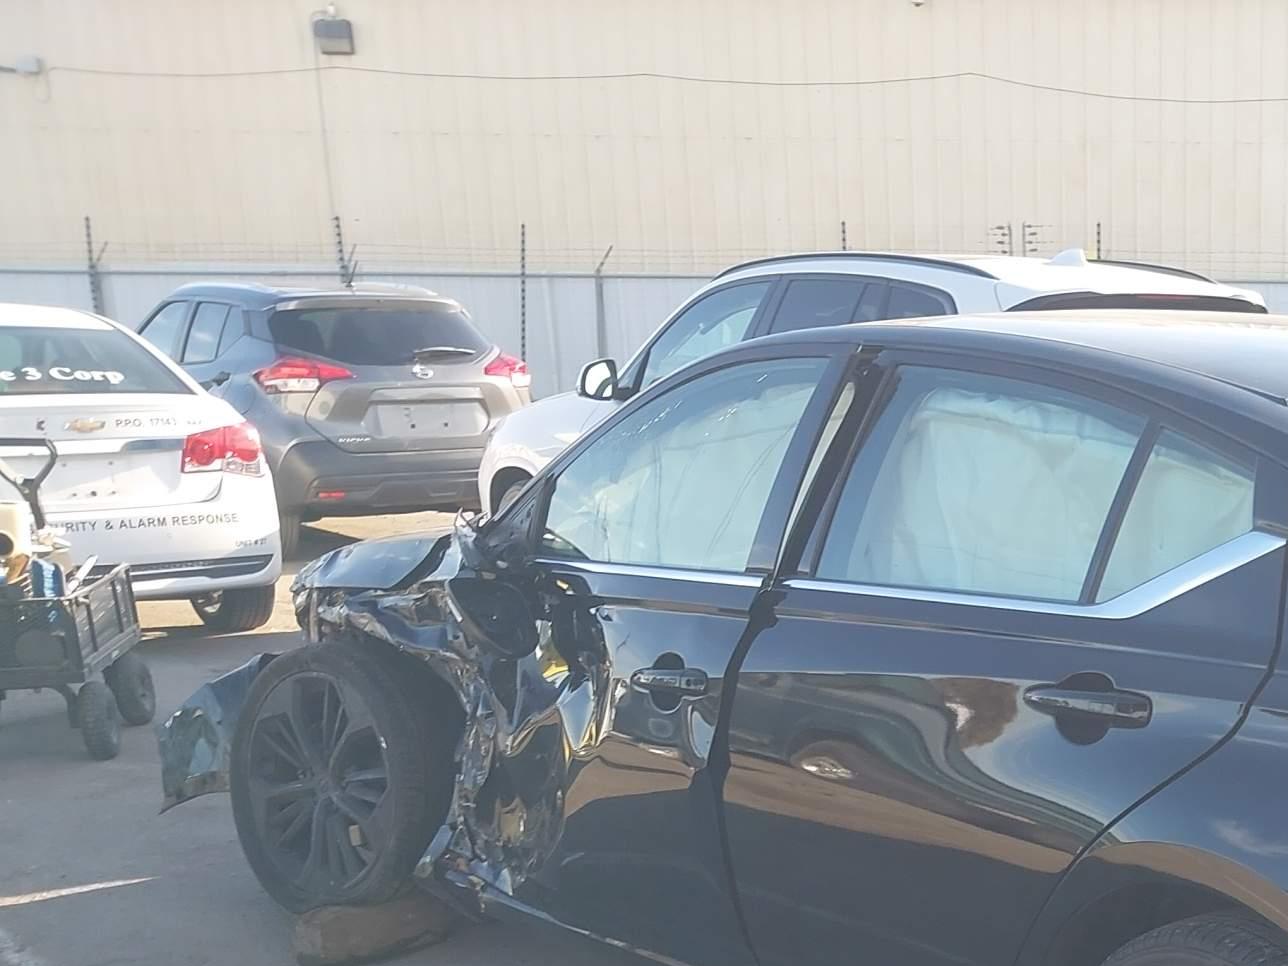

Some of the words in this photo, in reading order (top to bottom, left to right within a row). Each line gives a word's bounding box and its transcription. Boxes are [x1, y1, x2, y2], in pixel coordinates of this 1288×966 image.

[21, 367, 42, 380] 3
[49, 367, 125, 384] Corp
[104, 519, 114, 531] &
[119, 516, 168, 529] ALARM
[172, 512, 240, 526] RESPONSE
